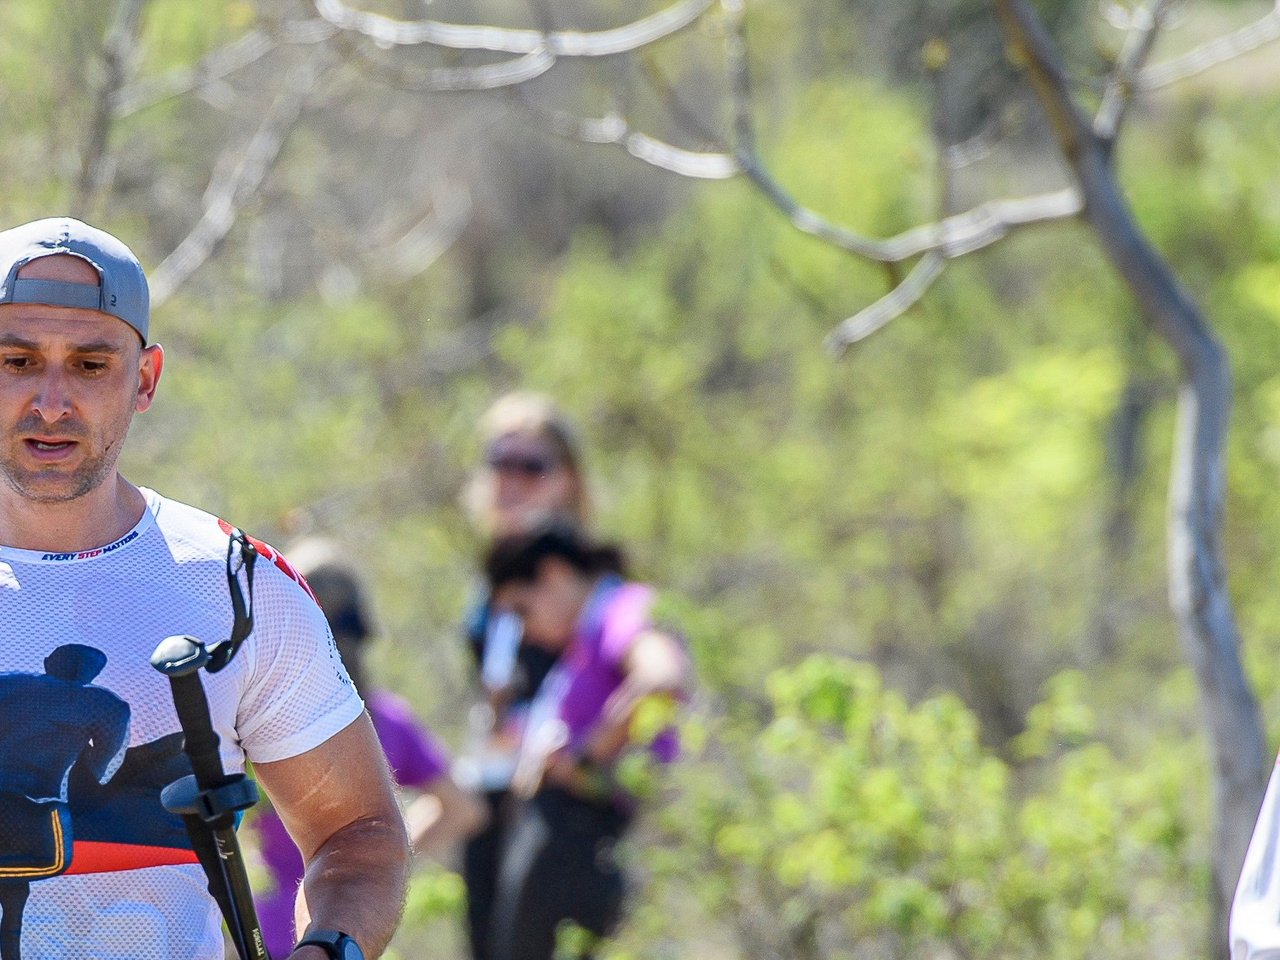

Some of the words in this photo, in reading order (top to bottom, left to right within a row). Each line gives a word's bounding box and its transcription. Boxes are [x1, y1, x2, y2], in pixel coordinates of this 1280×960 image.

[42, 553, 77, 561] EVERY
[78, 549, 102, 559] STEP
[103, 531, 138, 554] MATTERS
